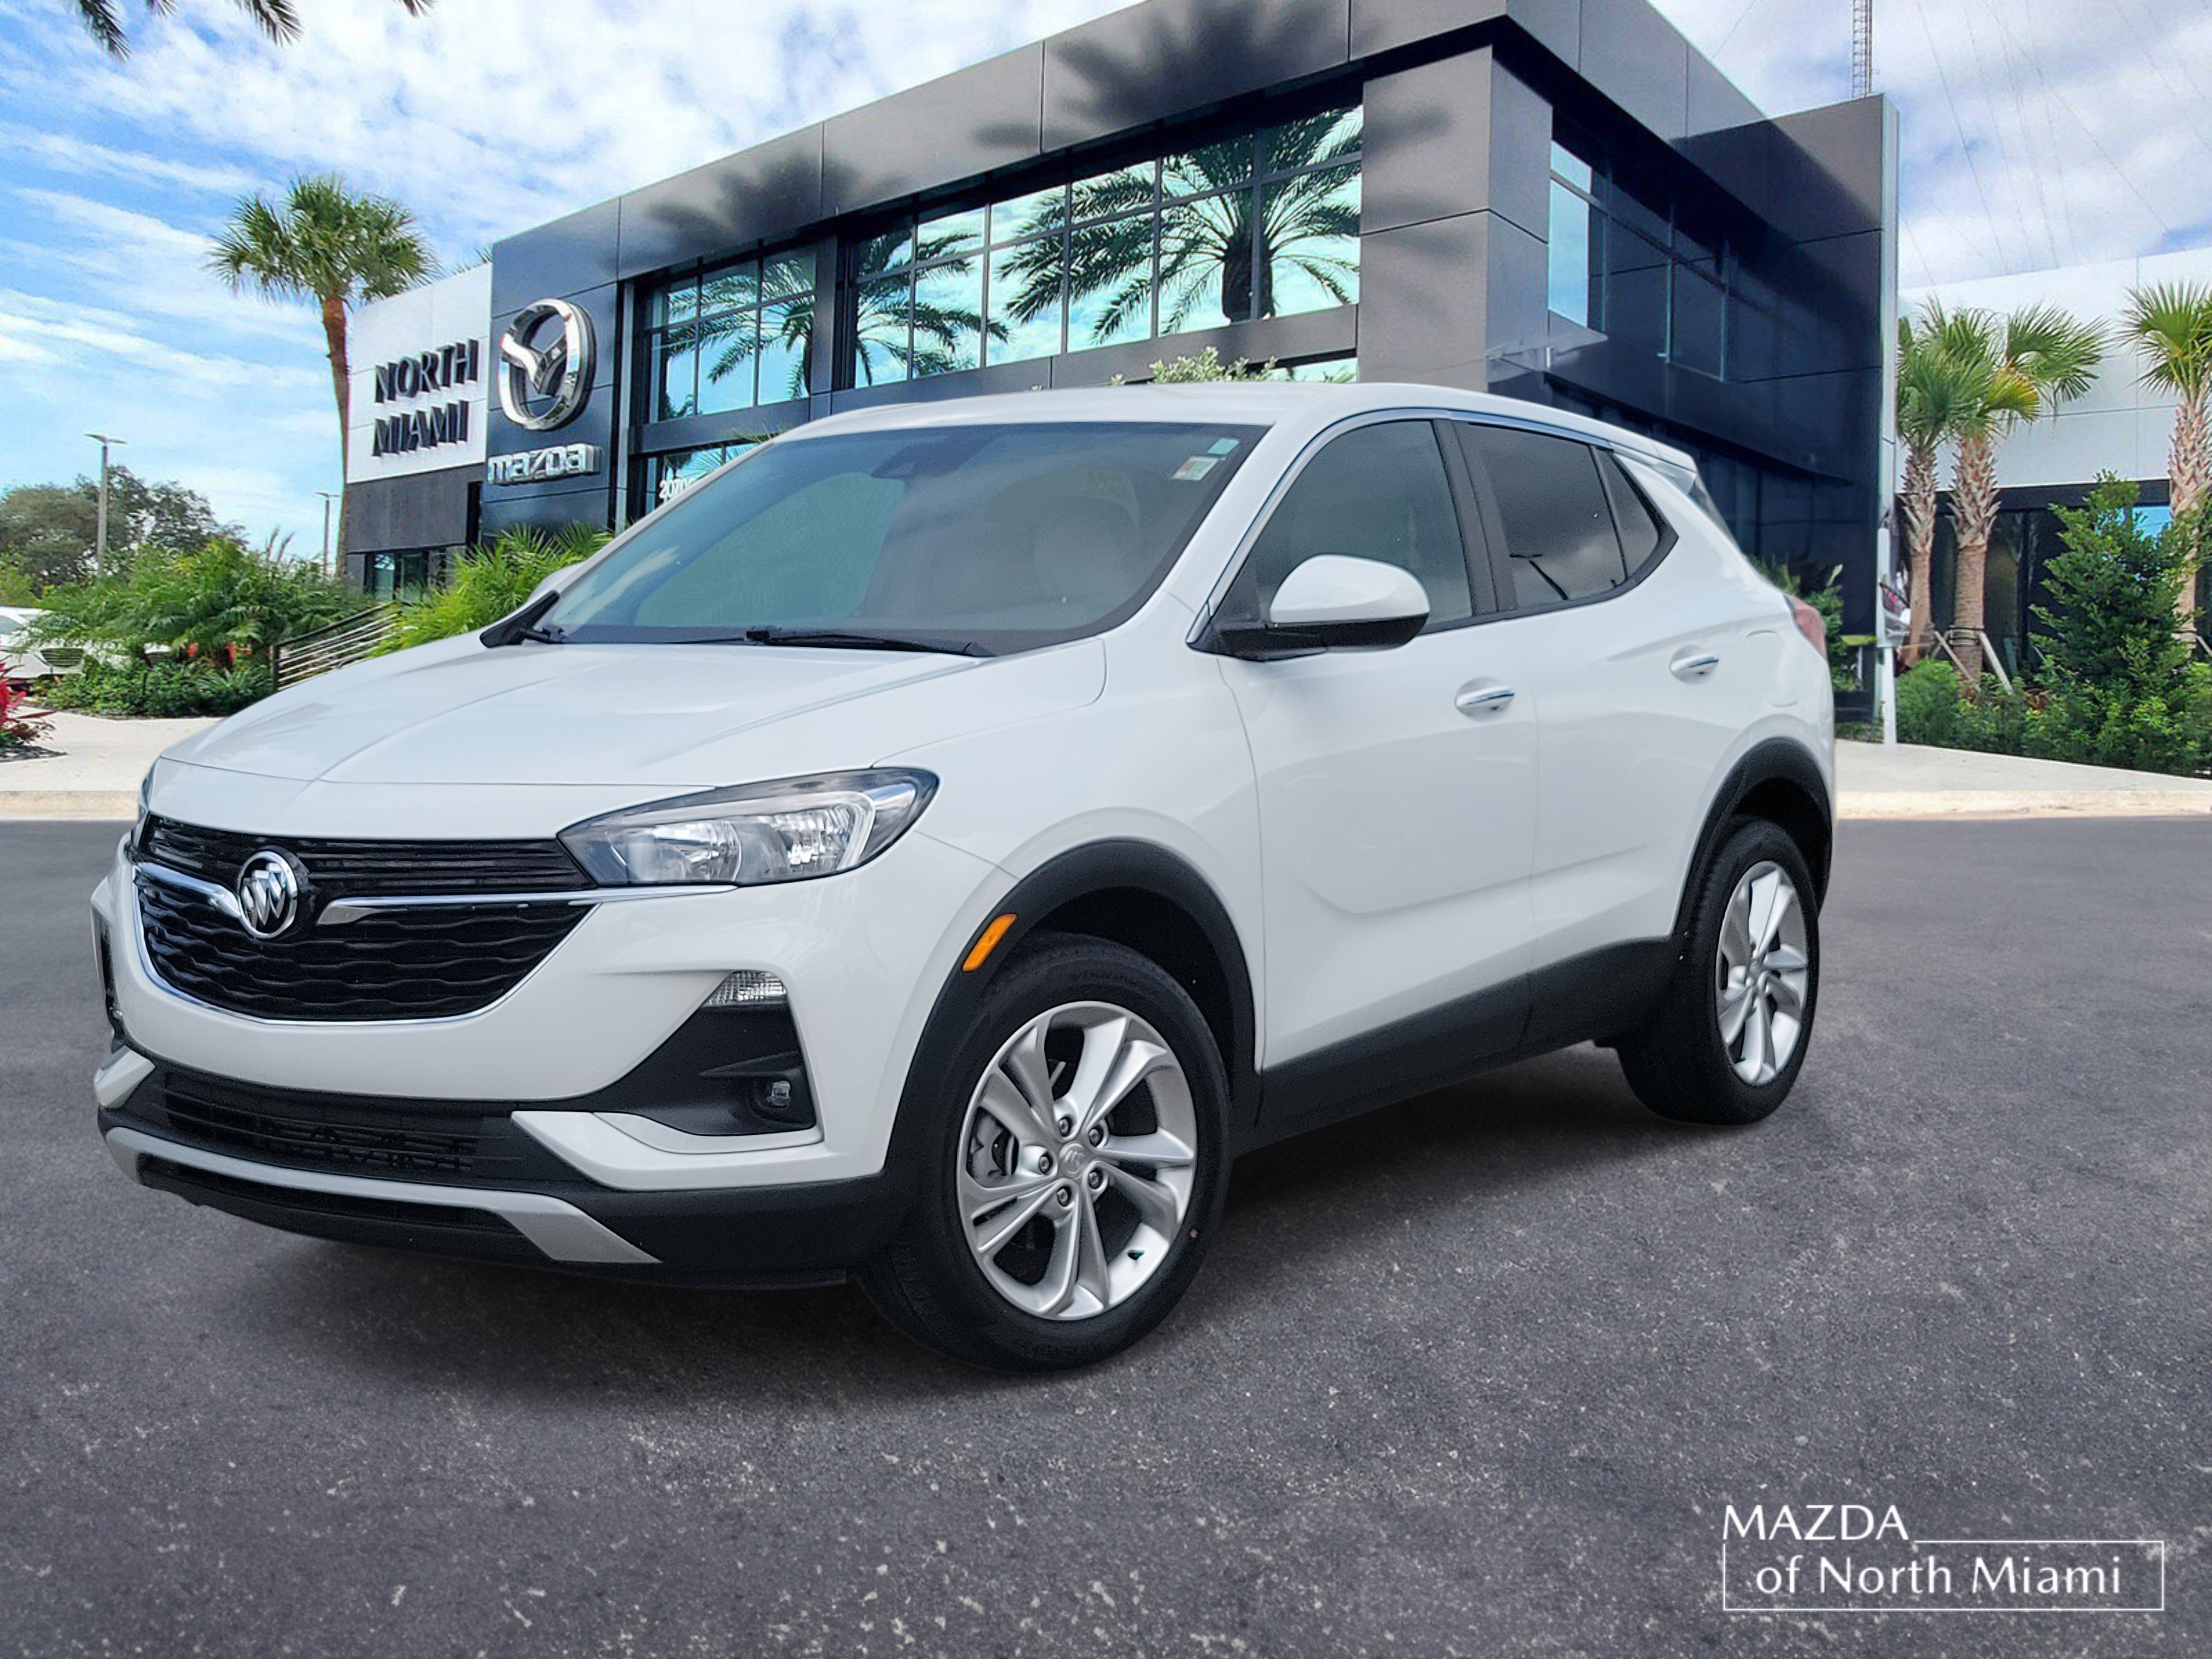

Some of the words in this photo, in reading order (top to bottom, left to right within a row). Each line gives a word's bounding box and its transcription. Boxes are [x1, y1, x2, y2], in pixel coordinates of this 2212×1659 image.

[375, 338, 479, 404] NORTH
[372, 400, 469, 457] MIAMI
[487, 443, 598, 485] mazda
